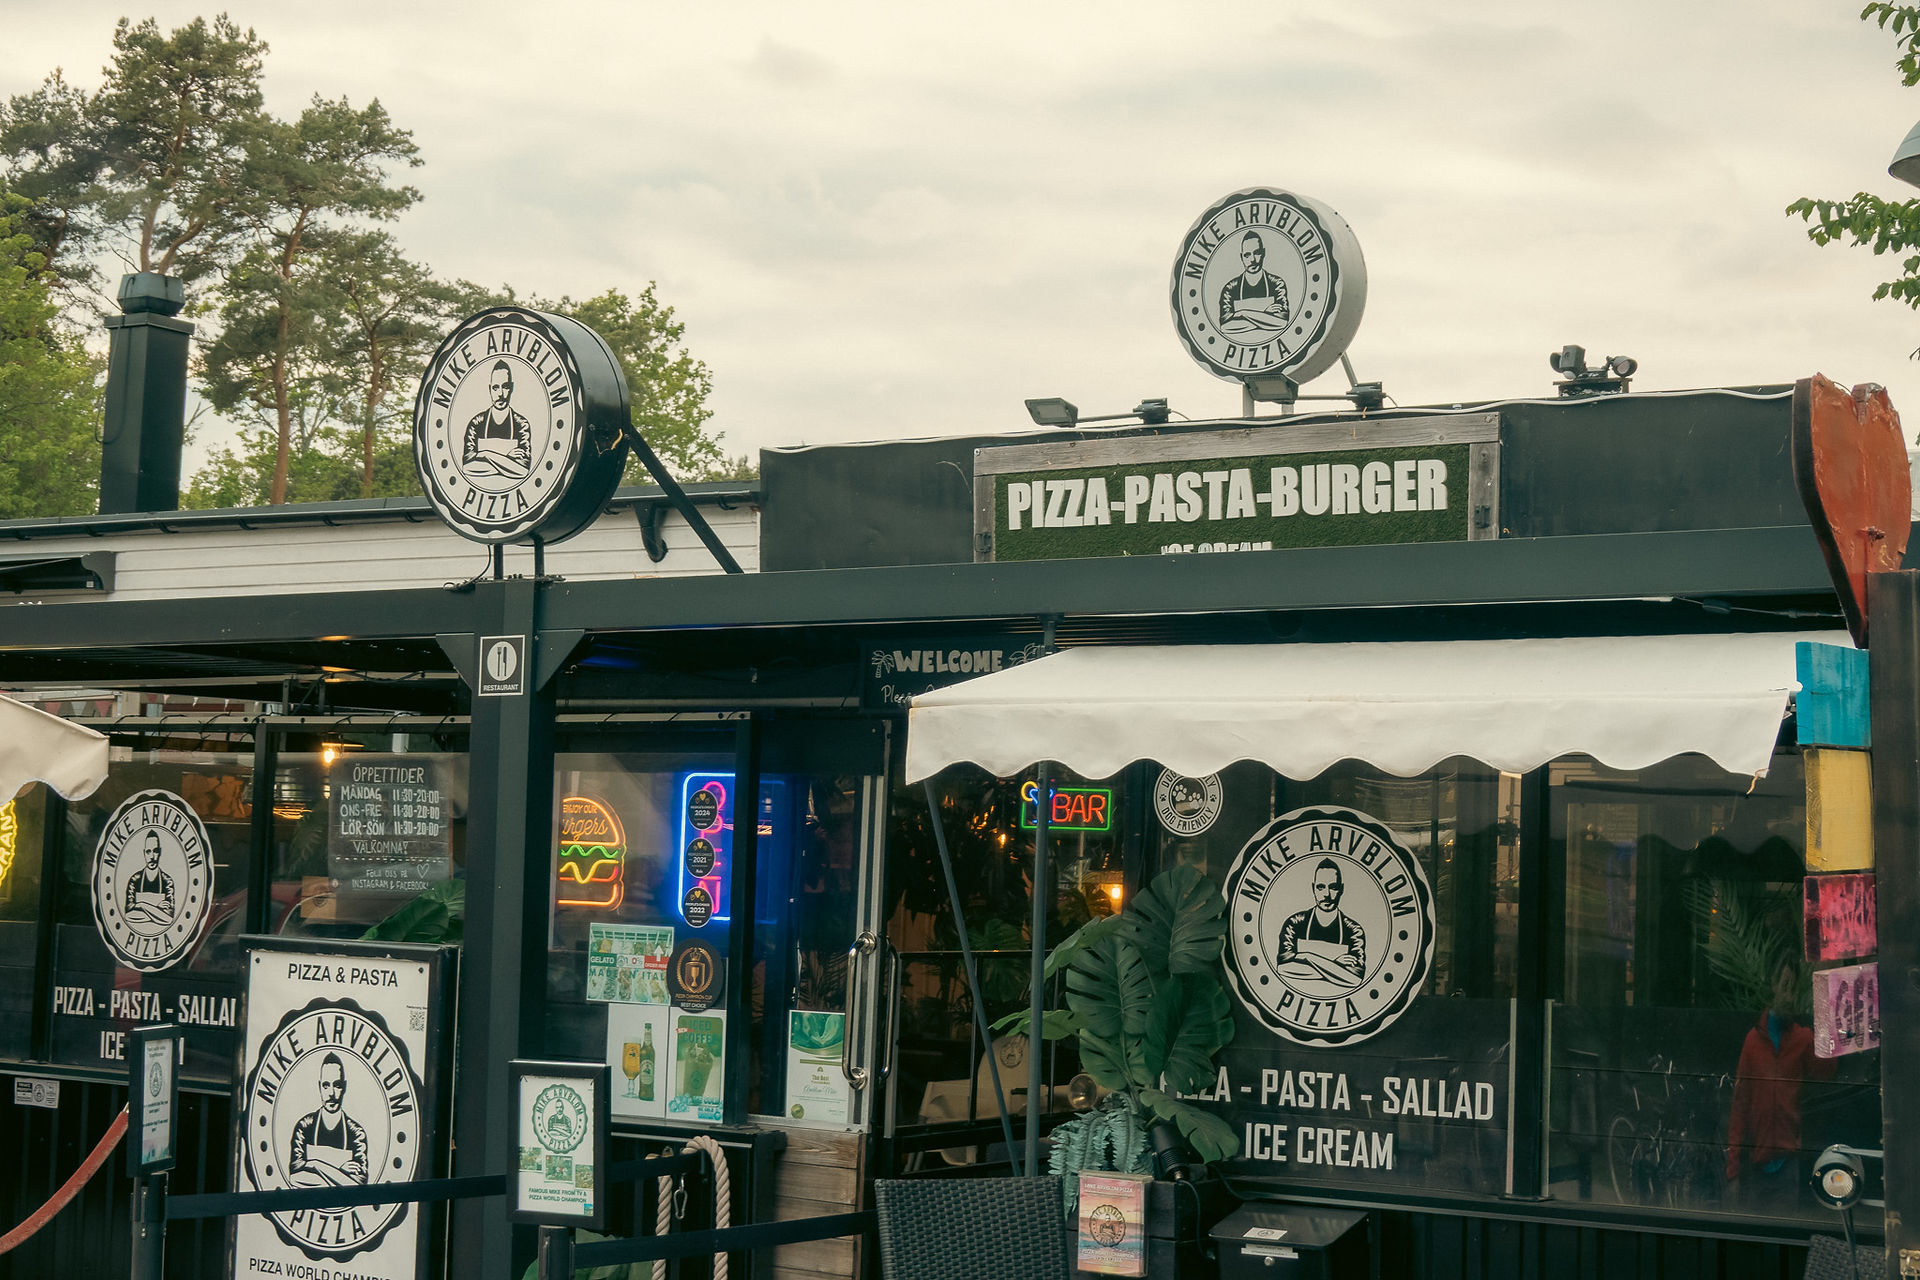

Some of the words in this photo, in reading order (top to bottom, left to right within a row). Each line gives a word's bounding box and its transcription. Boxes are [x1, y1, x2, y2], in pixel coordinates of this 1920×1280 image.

[1185, 221, 1225, 281] MIKE
[1233, 202, 1324, 266] ARVBLOM
[1223, 338, 1291, 370] PIZZA
[433, 344, 476, 410] MIKE
[486, 328, 570, 410] ARVBLOM
[462, 486, 530, 519] PIZZA
[1007, 459, 1449, 531] PIZZA-PASTA-BURGER
[893, 650, 1003, 673] WELCOME
[483, 683, 519, 692] RESTAURANT
[353, 763, 424, 783] ÖPPETTIDER
[341, 784, 382, 801] MÅNDAG
[392, 789, 440, 803] 11:30-20:00
[340, 804, 382, 817] ONS-FRE
[393, 804, 440, 819] 11:30-20:00
[584, 804, 597, 813] OUR
[1052, 794, 1106, 824] BAR
[1161, 806, 1176, 825] DOG
[1177, 807, 1214, 831] FRIENDLY
[104, 817, 135, 869] MIKE
[141, 805, 202, 869] ARVBLOM
[341, 819, 385, 835] LÖR-SÖN
[394, 820, 439, 836] 11:30-20:00
[562, 817, 608, 841] urgers
[1240, 838, 1296, 903] MIKE
[1310, 825, 1417, 918] ARVBLOM
[125, 933, 173, 958] PIZZA
[590, 956, 614, 964] GELATO
[288, 963, 330, 983] PIZZA
[336, 967, 347, 983] &
[351, 967, 398, 988] PASTA
[642, 972, 665, 981] ITAL
[54, 985, 94, 1017] PIZZA
[110, 991, 161, 1021] PASTA
[1276, 989, 1362, 1027] PIZZA
[100, 1031, 125, 1060] ICE
[256, 1026, 304, 1105] MIKE
[315, 1015, 414, 1119] ARVBLOM
[536, 1093, 550, 1114] MIKE
[553, 1089, 584, 1115] ARVBLOM
[1261, 1068, 1351, 1111] PASTA
[1383, 1076, 1494, 1121] SALLAD
[548, 1140, 572, 1150] PIZZA
[1245, 1122, 1287, 1162] ICE
[1297, 1127, 1394, 1170] CREAM
[290, 1209, 366, 1244] PIZZA
[249, 1257, 282, 1275] PIZZA
[286, 1264, 330, 1280] WORLD
